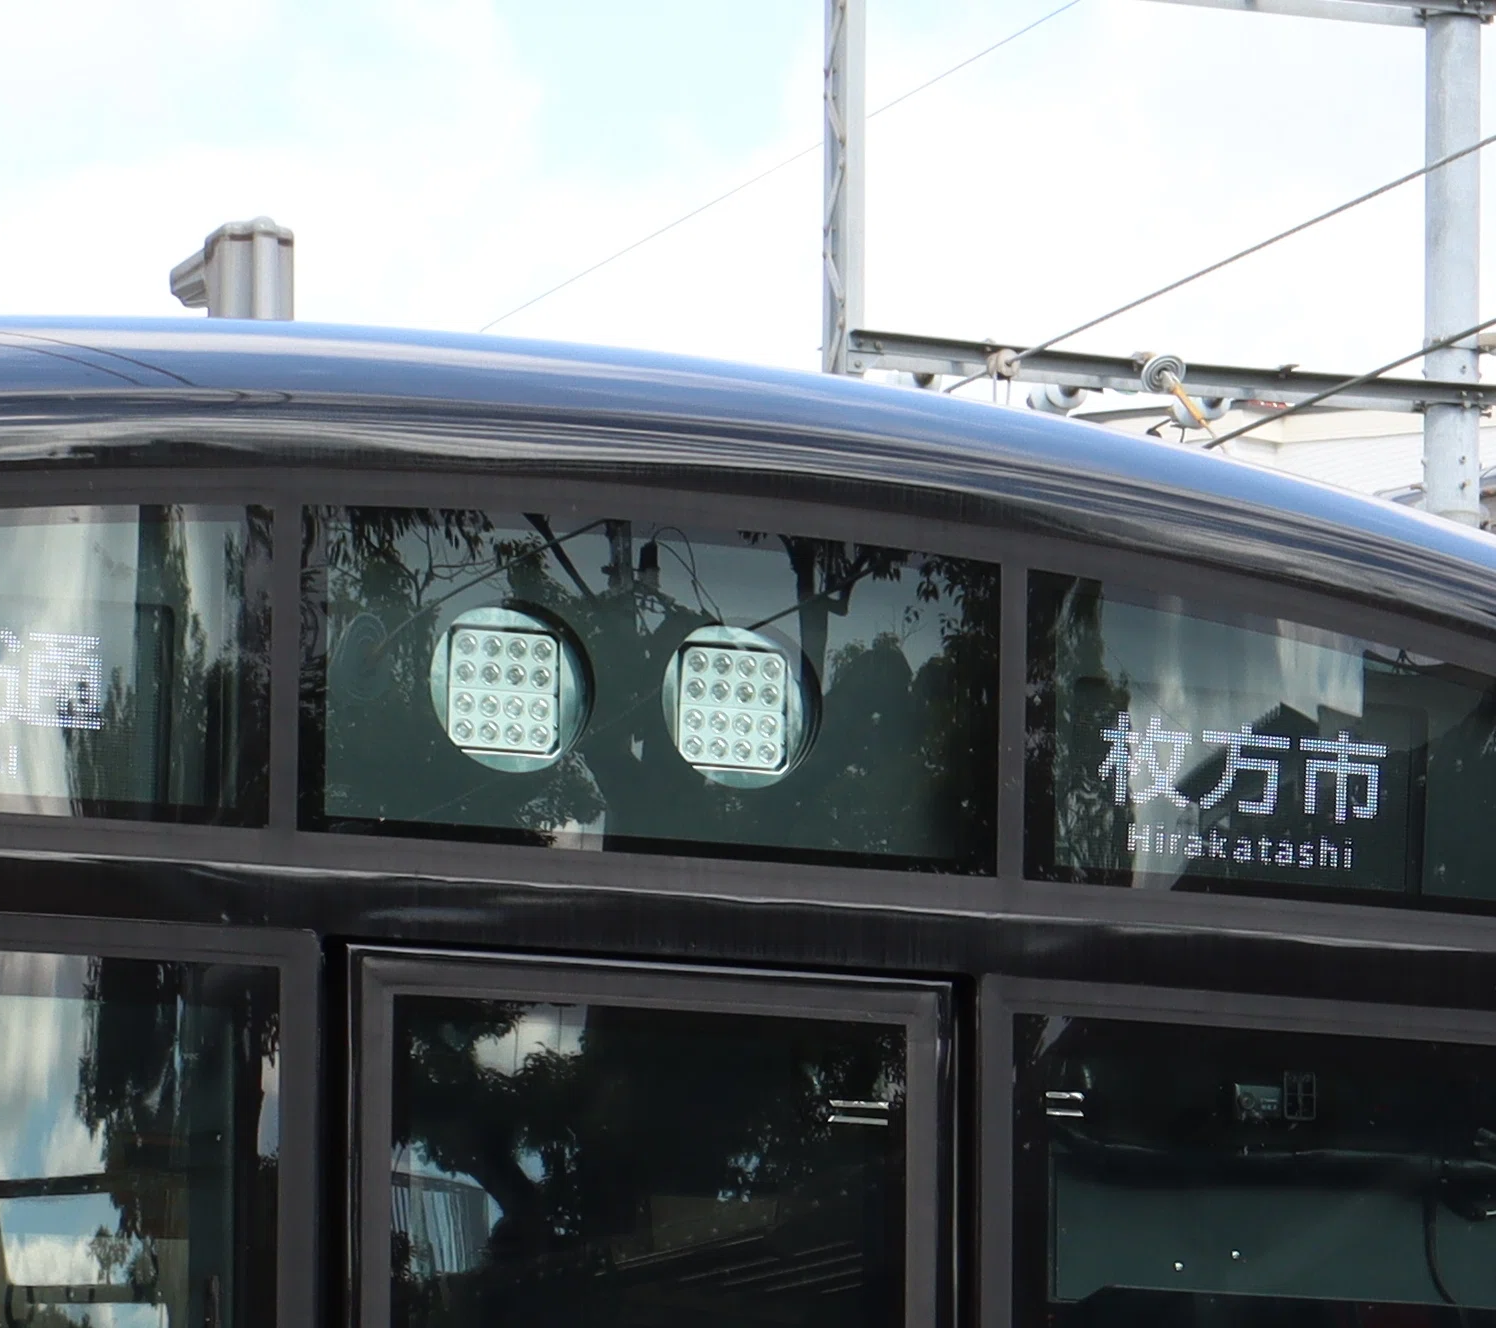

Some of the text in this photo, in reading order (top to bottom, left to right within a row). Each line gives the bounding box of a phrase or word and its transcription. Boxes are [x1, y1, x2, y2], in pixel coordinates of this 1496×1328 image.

[1098, 710, 1388, 824] 枚方市
[1125, 822, 1354, 870] Hirakatashi
